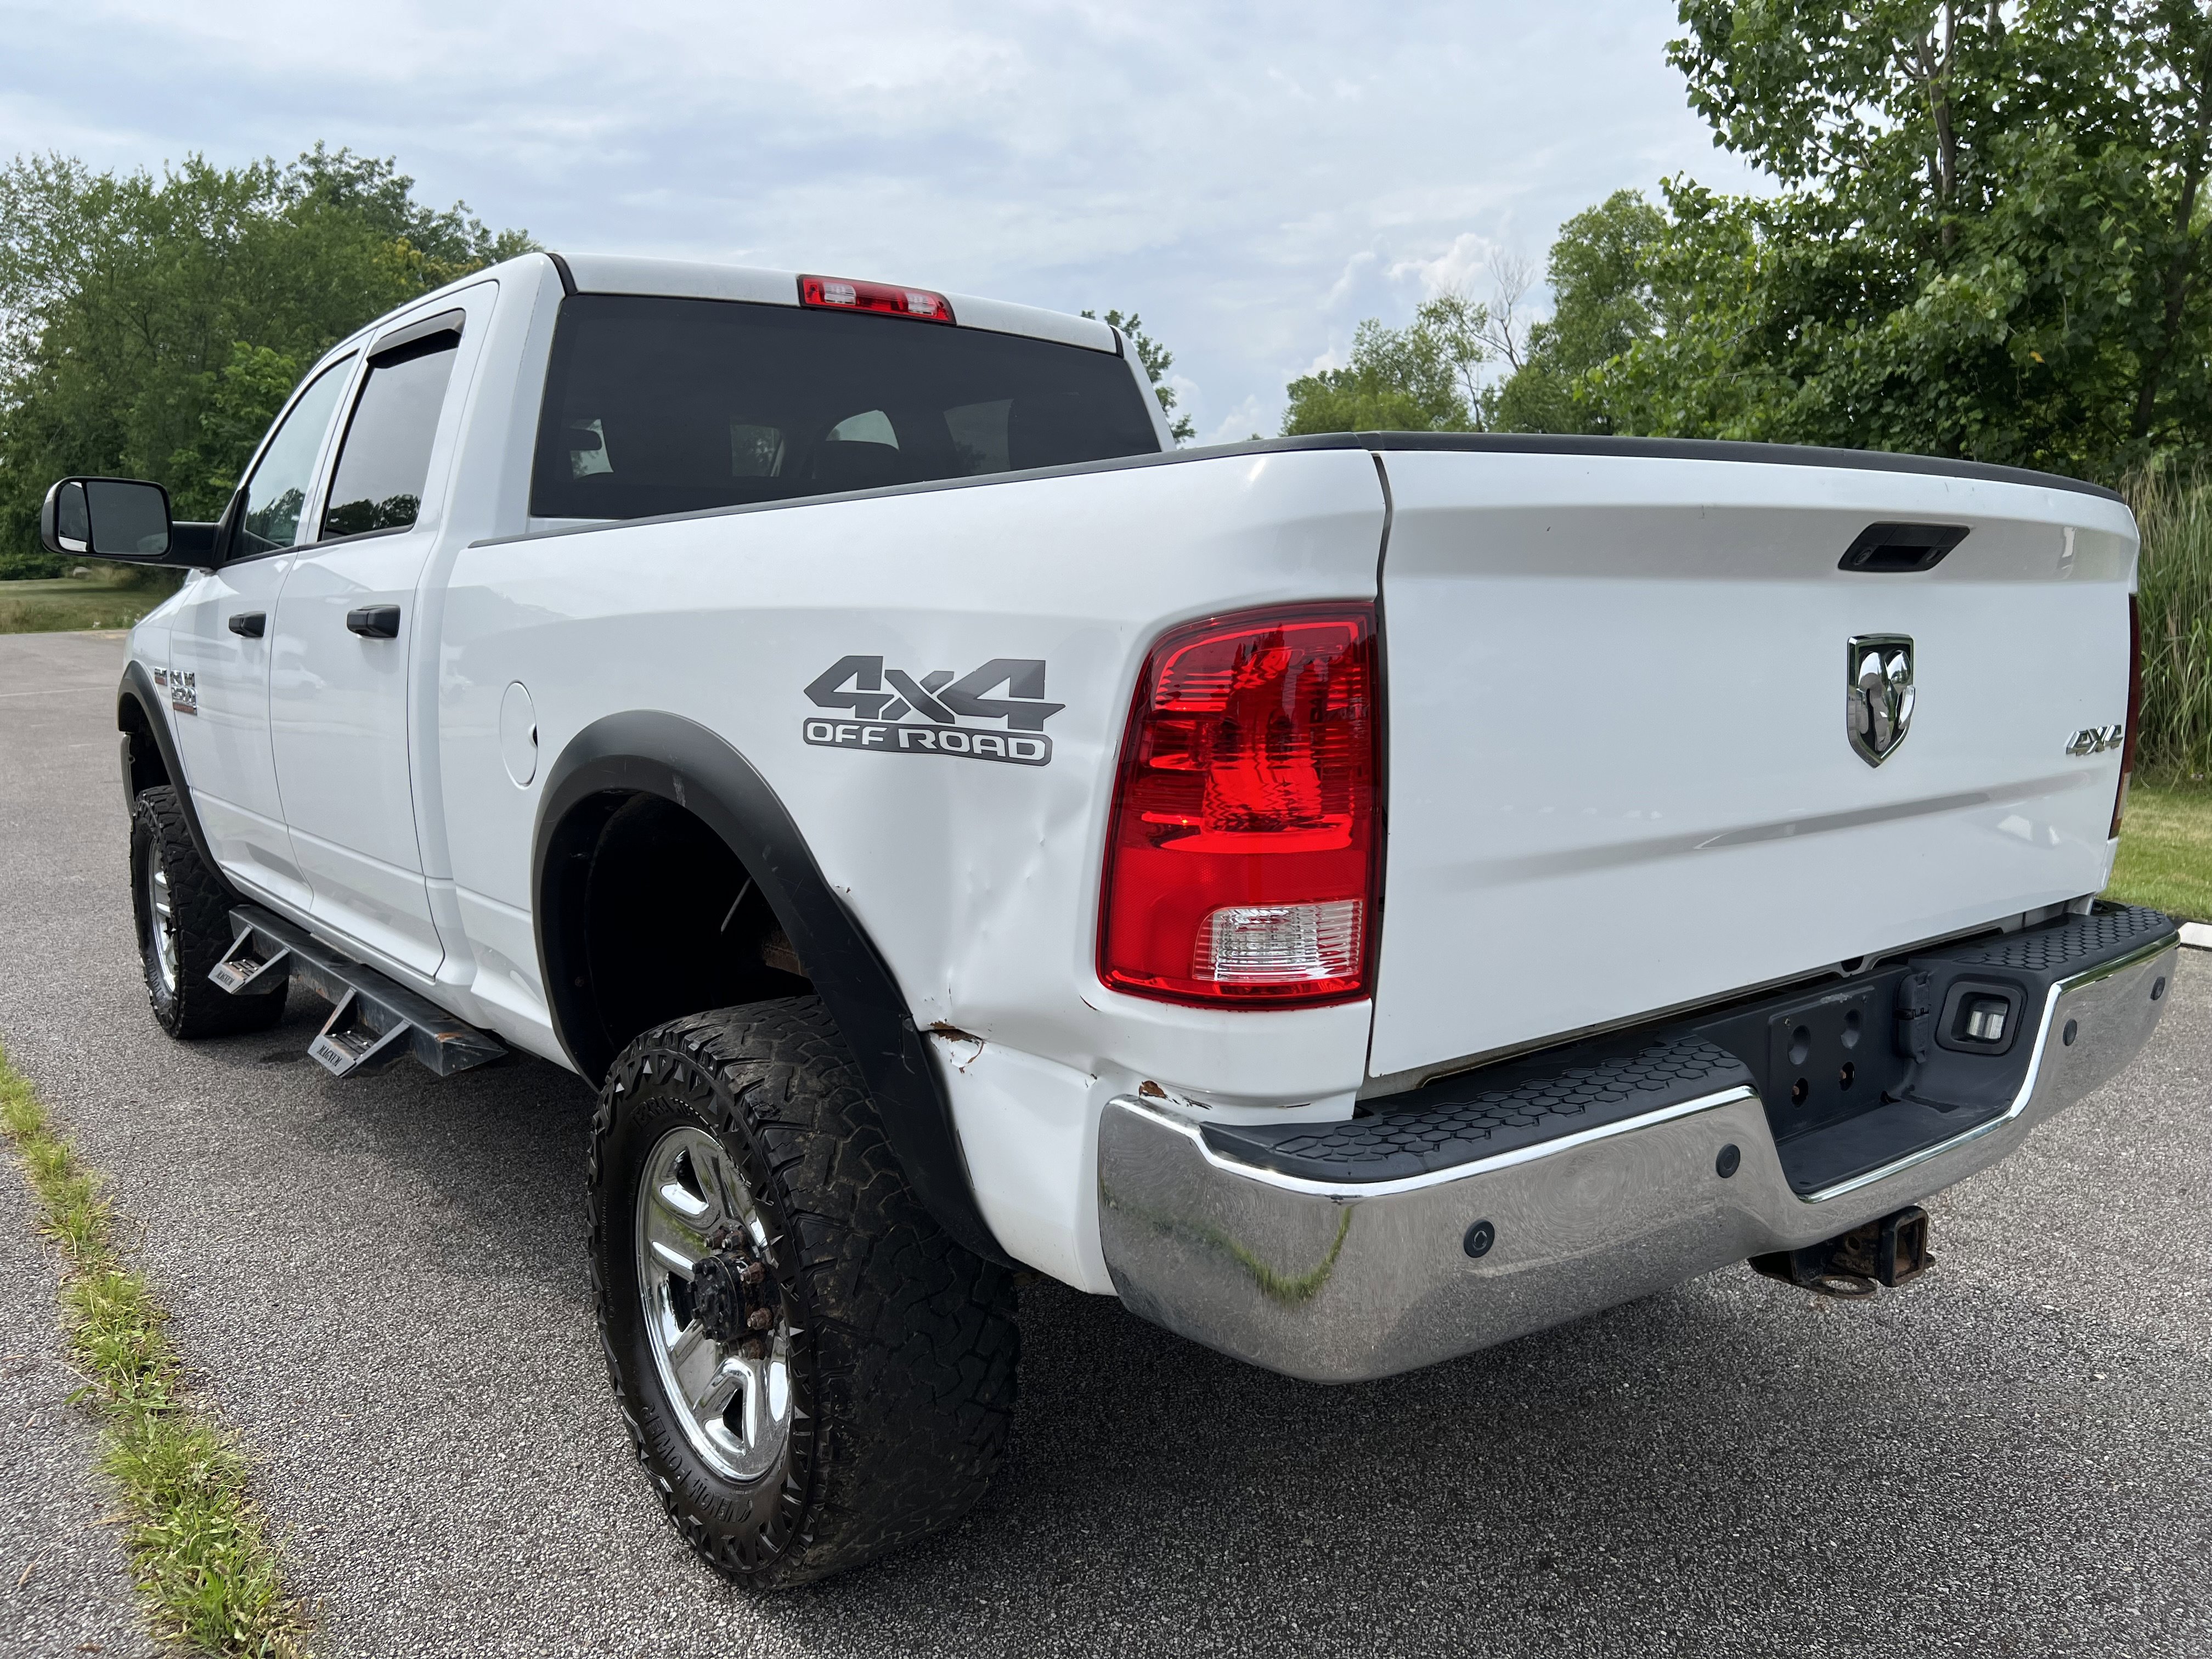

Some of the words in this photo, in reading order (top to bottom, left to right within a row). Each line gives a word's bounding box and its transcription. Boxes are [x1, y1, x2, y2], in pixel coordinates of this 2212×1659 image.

[807, 722, 888, 746] OFF
[898, 727, 1046, 761] ROAD
[317, 1045, 343, 1067] MAGNUM
[640, 1403, 692, 1486] POWER
